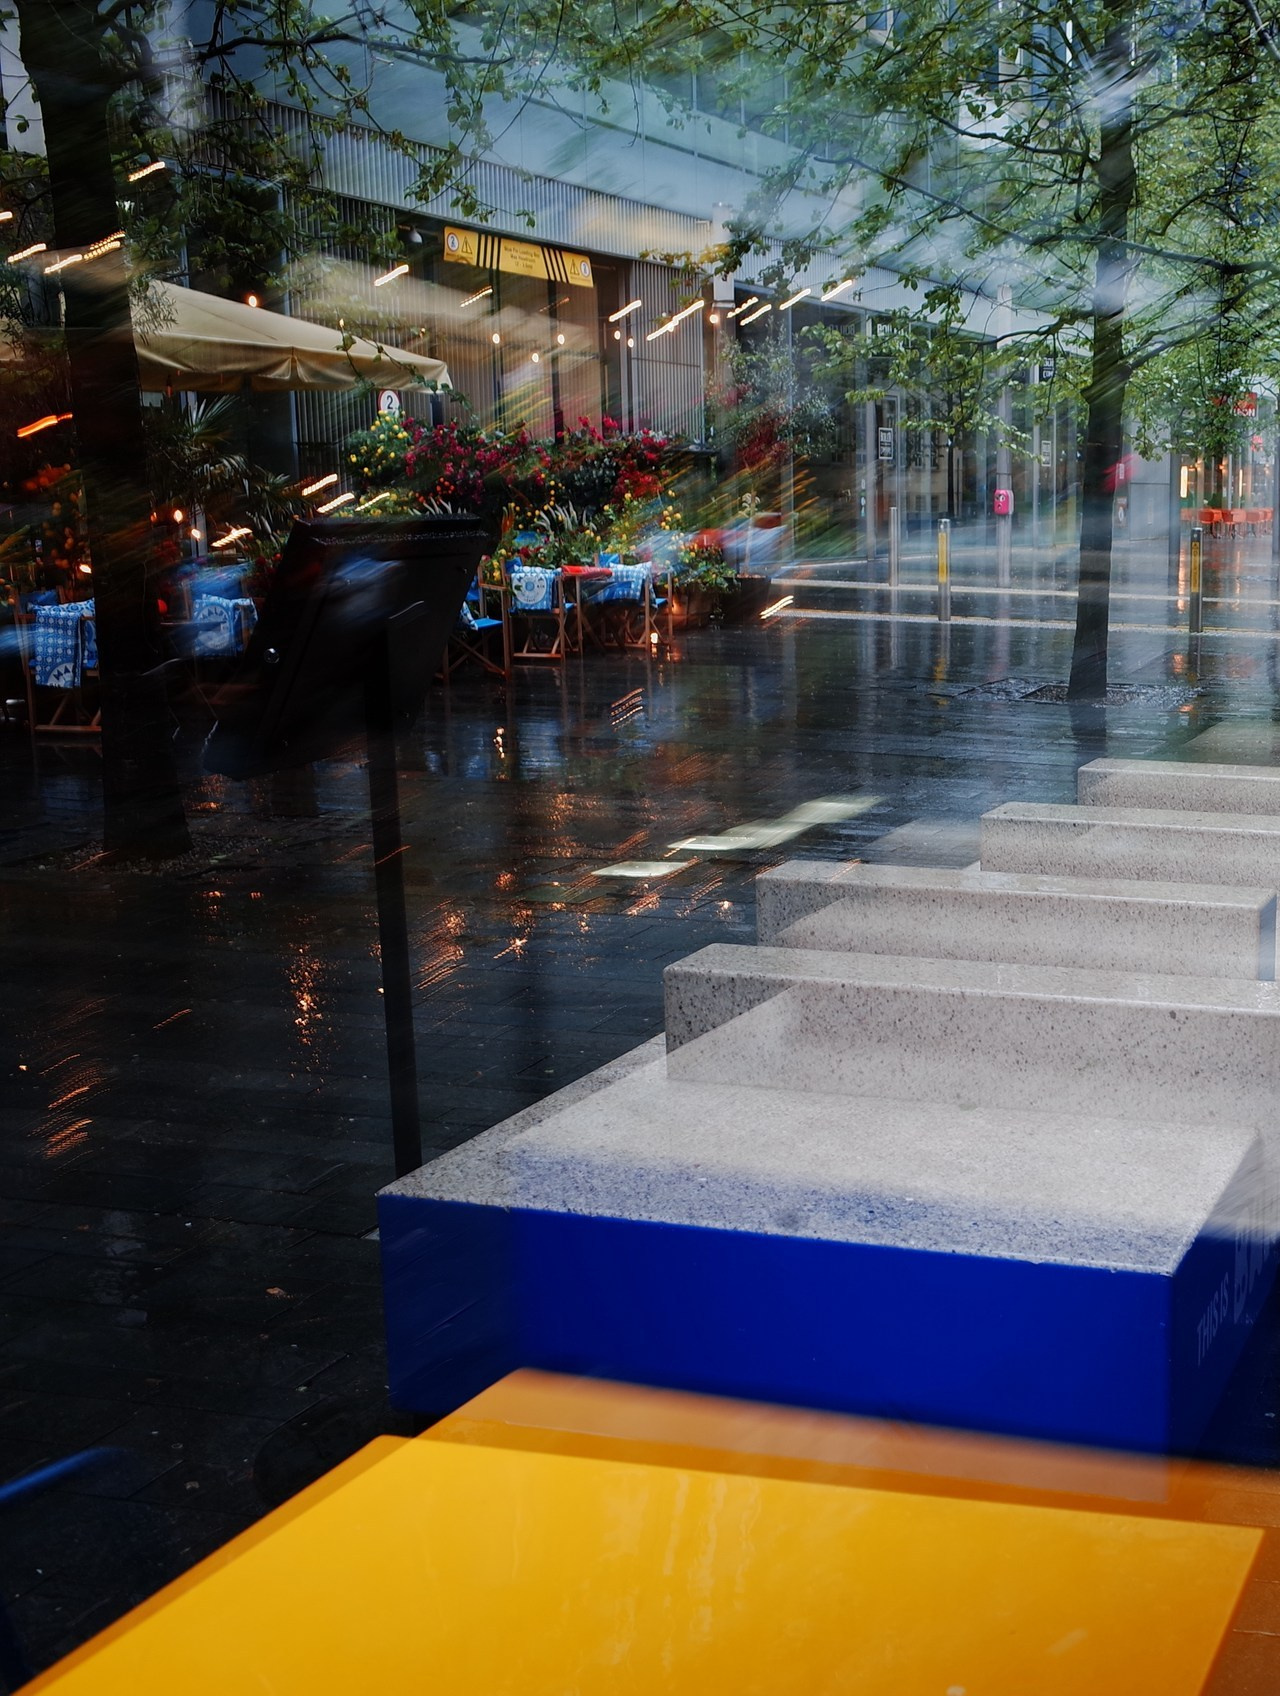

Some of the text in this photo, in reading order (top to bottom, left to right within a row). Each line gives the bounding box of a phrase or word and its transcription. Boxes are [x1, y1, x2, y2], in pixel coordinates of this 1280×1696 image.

[386, 394, 394, 410] 2
[1197, 1291, 1219, 1366] THIS
[1220, 1271, 1229, 1324] IS
